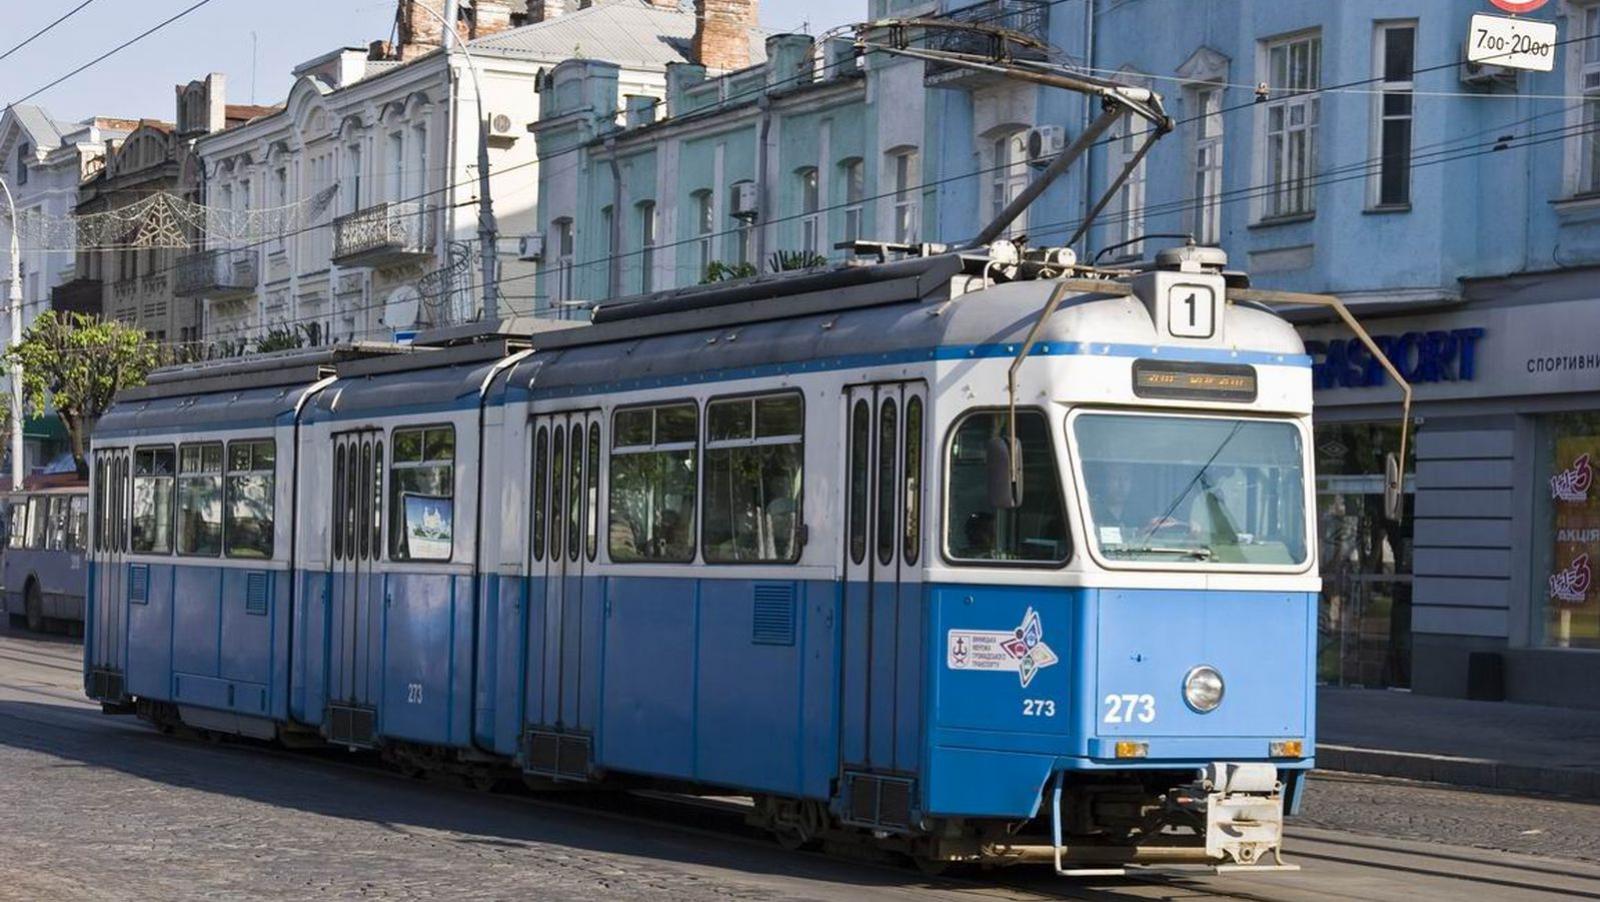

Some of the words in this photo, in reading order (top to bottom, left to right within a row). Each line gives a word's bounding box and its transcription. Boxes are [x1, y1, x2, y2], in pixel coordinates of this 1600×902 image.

[1184, 293, 1196, 327] 1
[408, 683, 423, 704] 273
[1023, 699, 1056, 717] 273
[1103, 694, 1155, 723] 273
